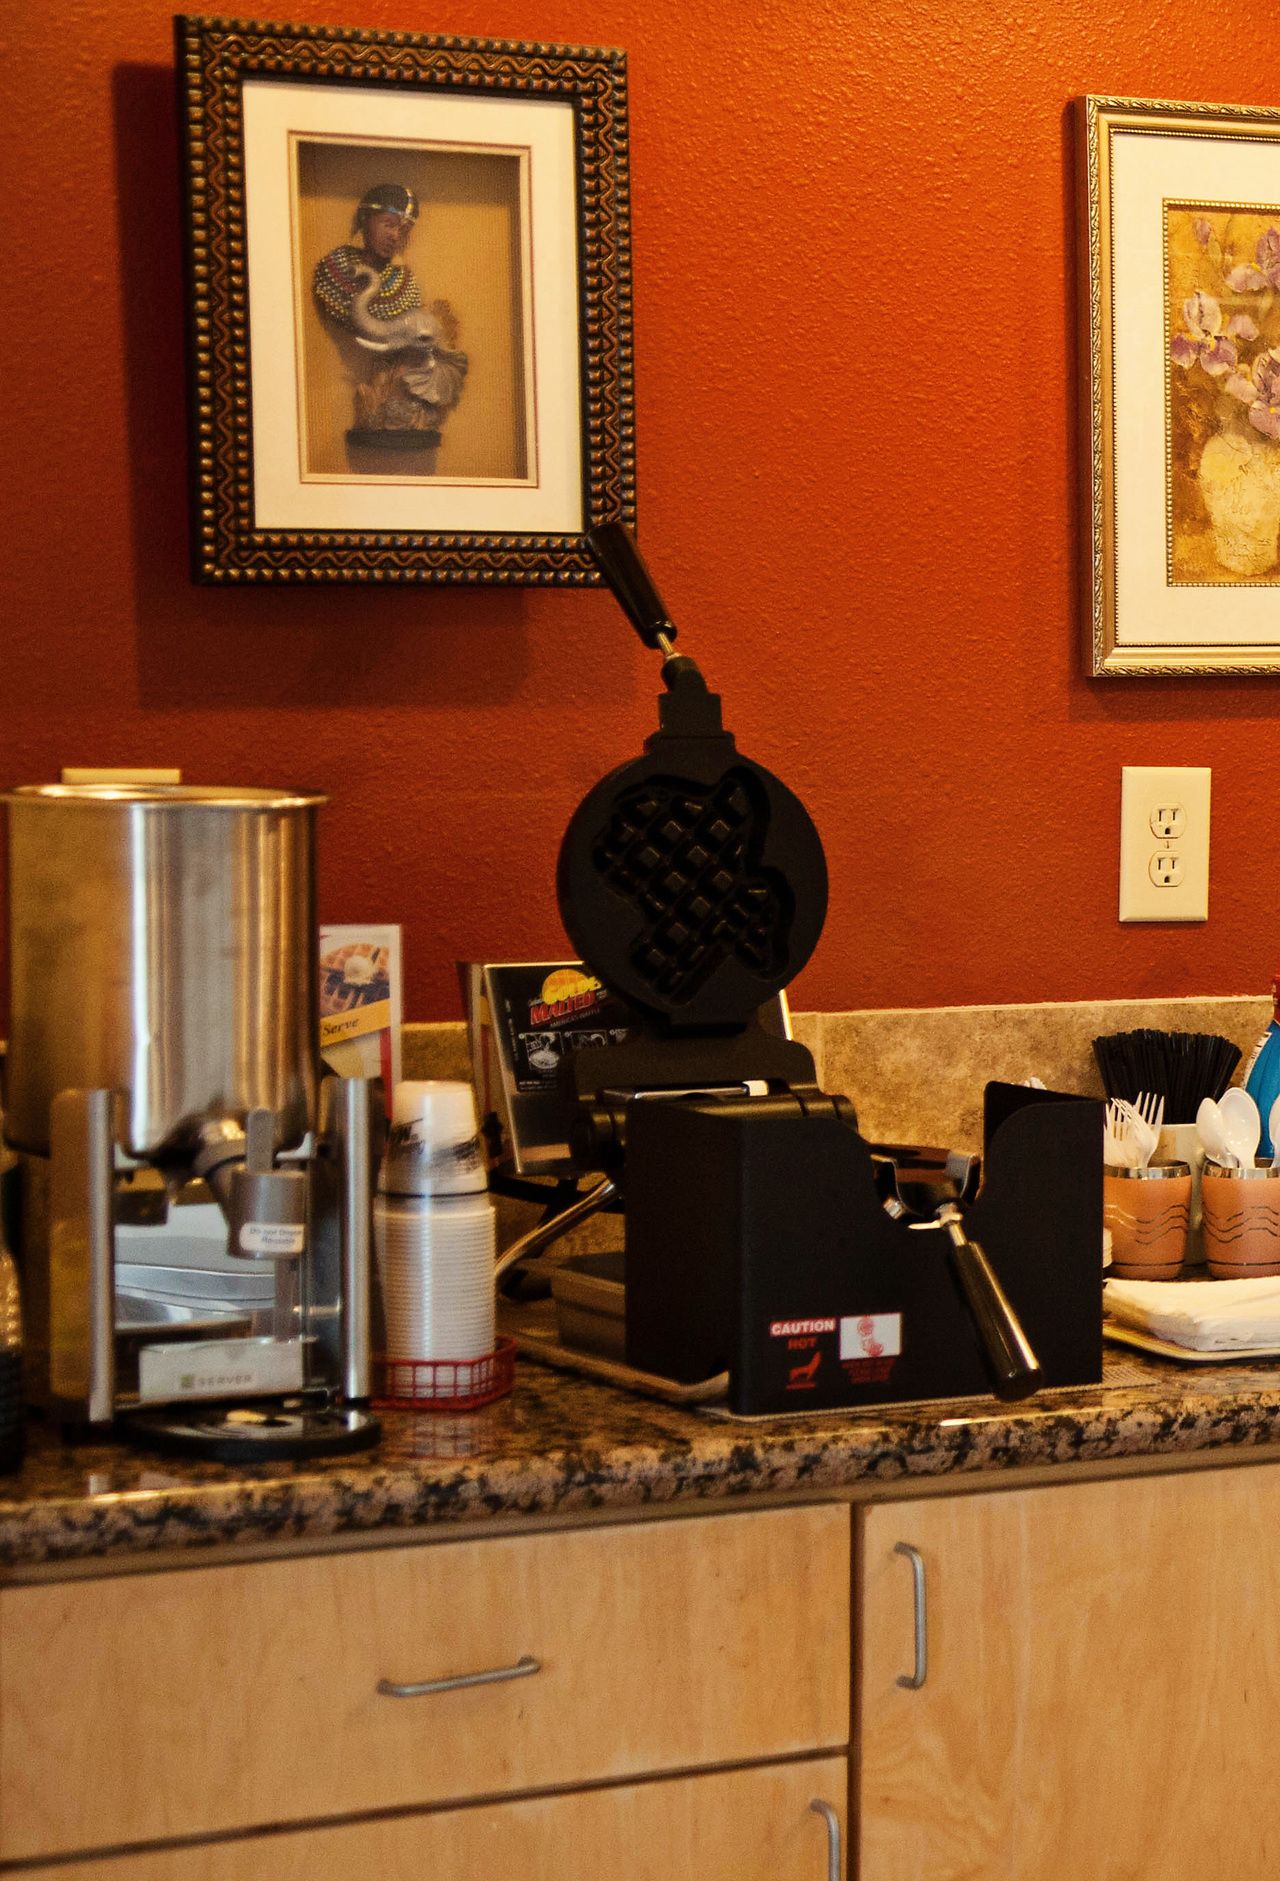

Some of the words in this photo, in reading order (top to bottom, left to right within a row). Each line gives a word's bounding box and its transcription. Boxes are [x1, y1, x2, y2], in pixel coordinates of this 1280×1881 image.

[530, 991, 596, 1026] MALTED
[322, 1018, 360, 1038] Serve
[770, 1319, 835, 1336] CAUTION
[788, 1338, 817, 1350] HOT
[200, 1373, 253, 1387] SERVER
